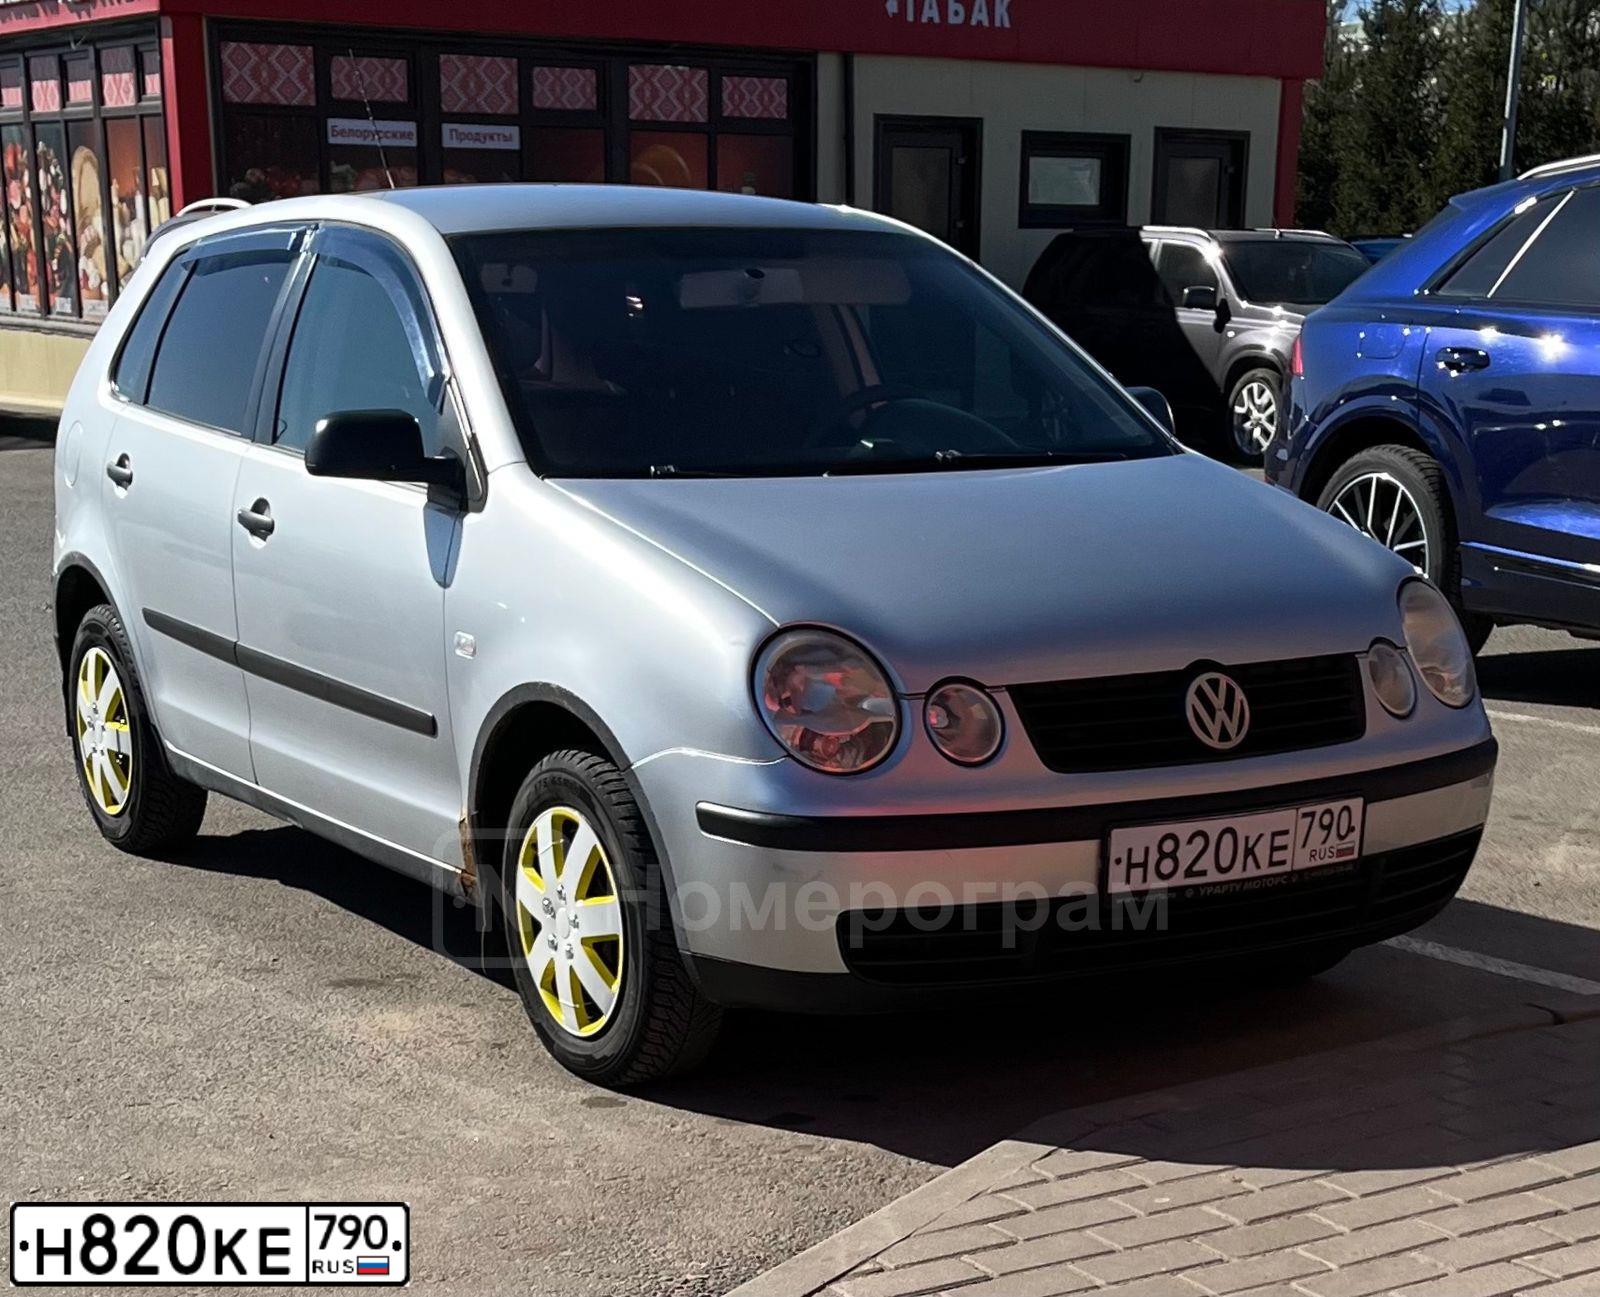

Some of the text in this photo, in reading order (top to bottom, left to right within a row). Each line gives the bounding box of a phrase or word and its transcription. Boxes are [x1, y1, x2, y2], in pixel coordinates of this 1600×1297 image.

[330, 124, 415, 142] Белорусские
[448, 128, 513, 144] Продукты
[1125, 804, 1352, 885] Н820КЕ 790
[1308, 845, 1335, 863] RUS
